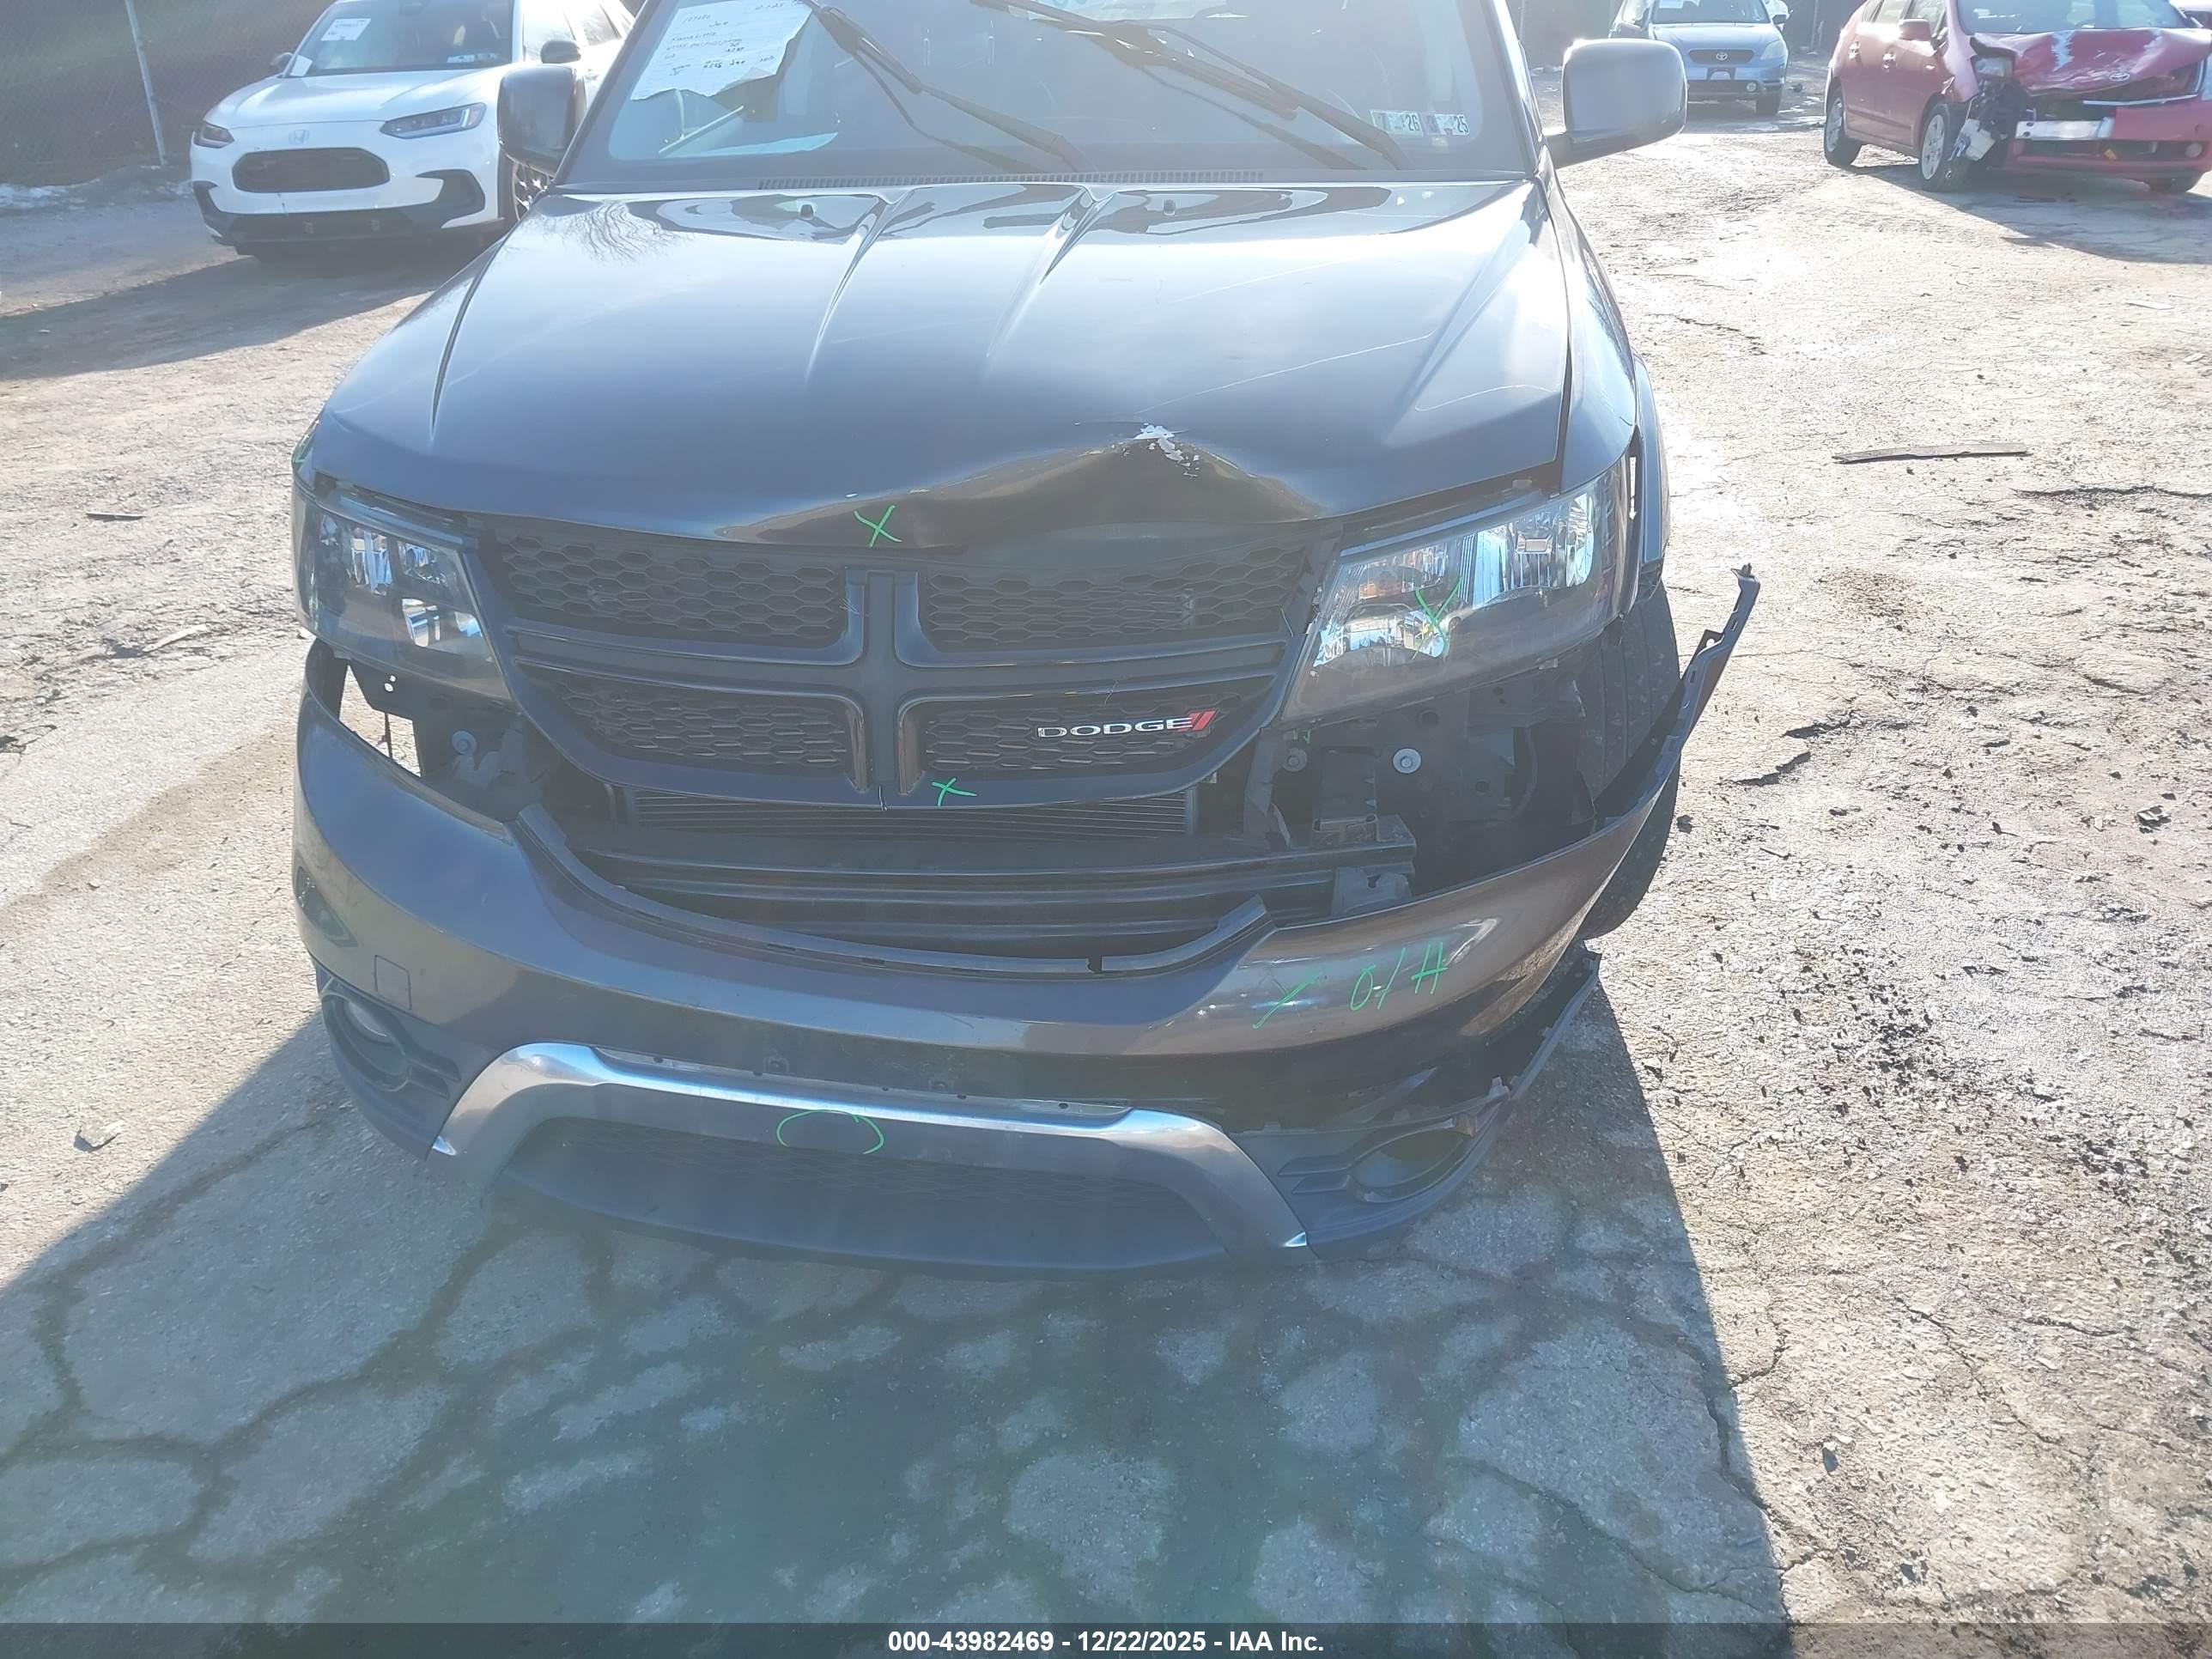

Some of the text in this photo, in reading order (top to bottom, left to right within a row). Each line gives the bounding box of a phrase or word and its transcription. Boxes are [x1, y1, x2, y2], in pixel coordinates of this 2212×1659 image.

[1405, 113, 1420, 131] 26
[1453, 115, 1469, 133] 25
[1037, 717, 1194, 738] DODGE
